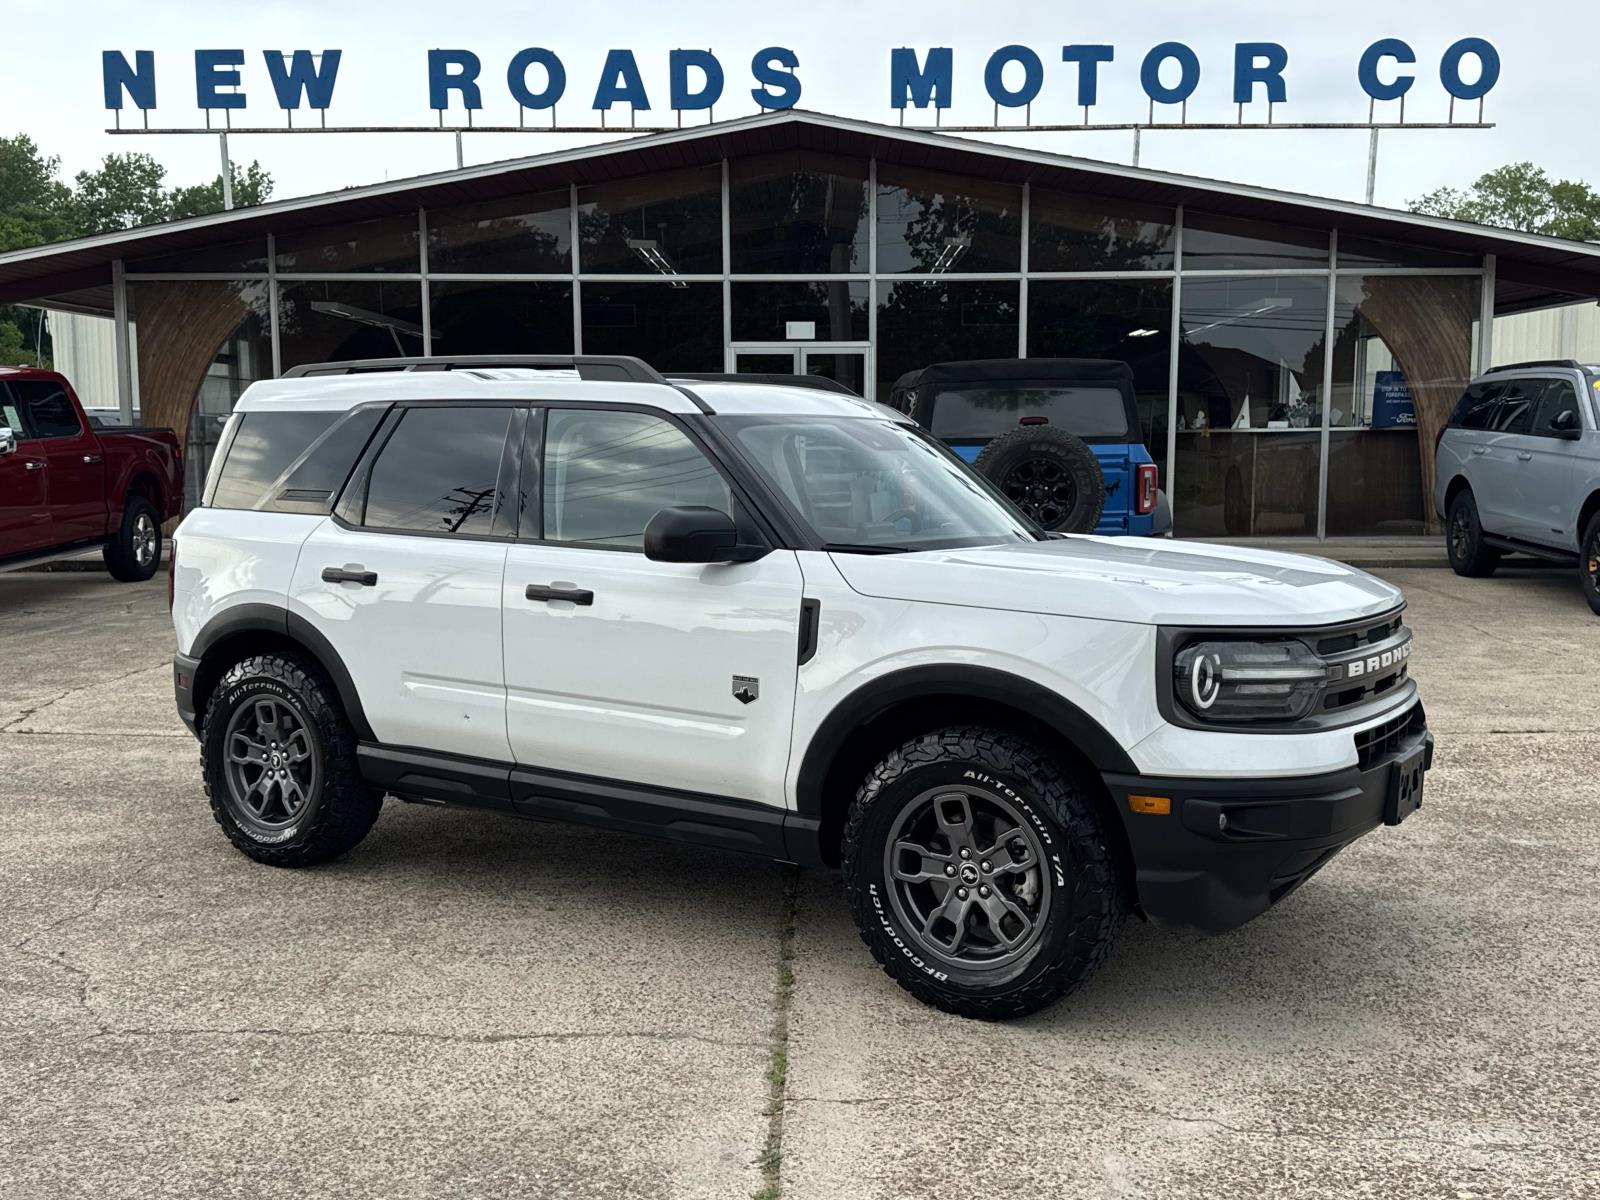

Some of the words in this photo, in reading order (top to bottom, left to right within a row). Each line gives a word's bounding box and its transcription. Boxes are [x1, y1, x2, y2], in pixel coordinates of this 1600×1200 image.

[103, 50, 341, 110] NEW
[428, 47, 801, 111] ROADS
[891, 42, 1288, 110] MOTOR
[1358, 37, 1500, 101] CO
[963, 769, 1053, 844] All-Terrain
[1052, 853, 1065, 887] T/A
[869, 883, 949, 982] BFGoodrich
